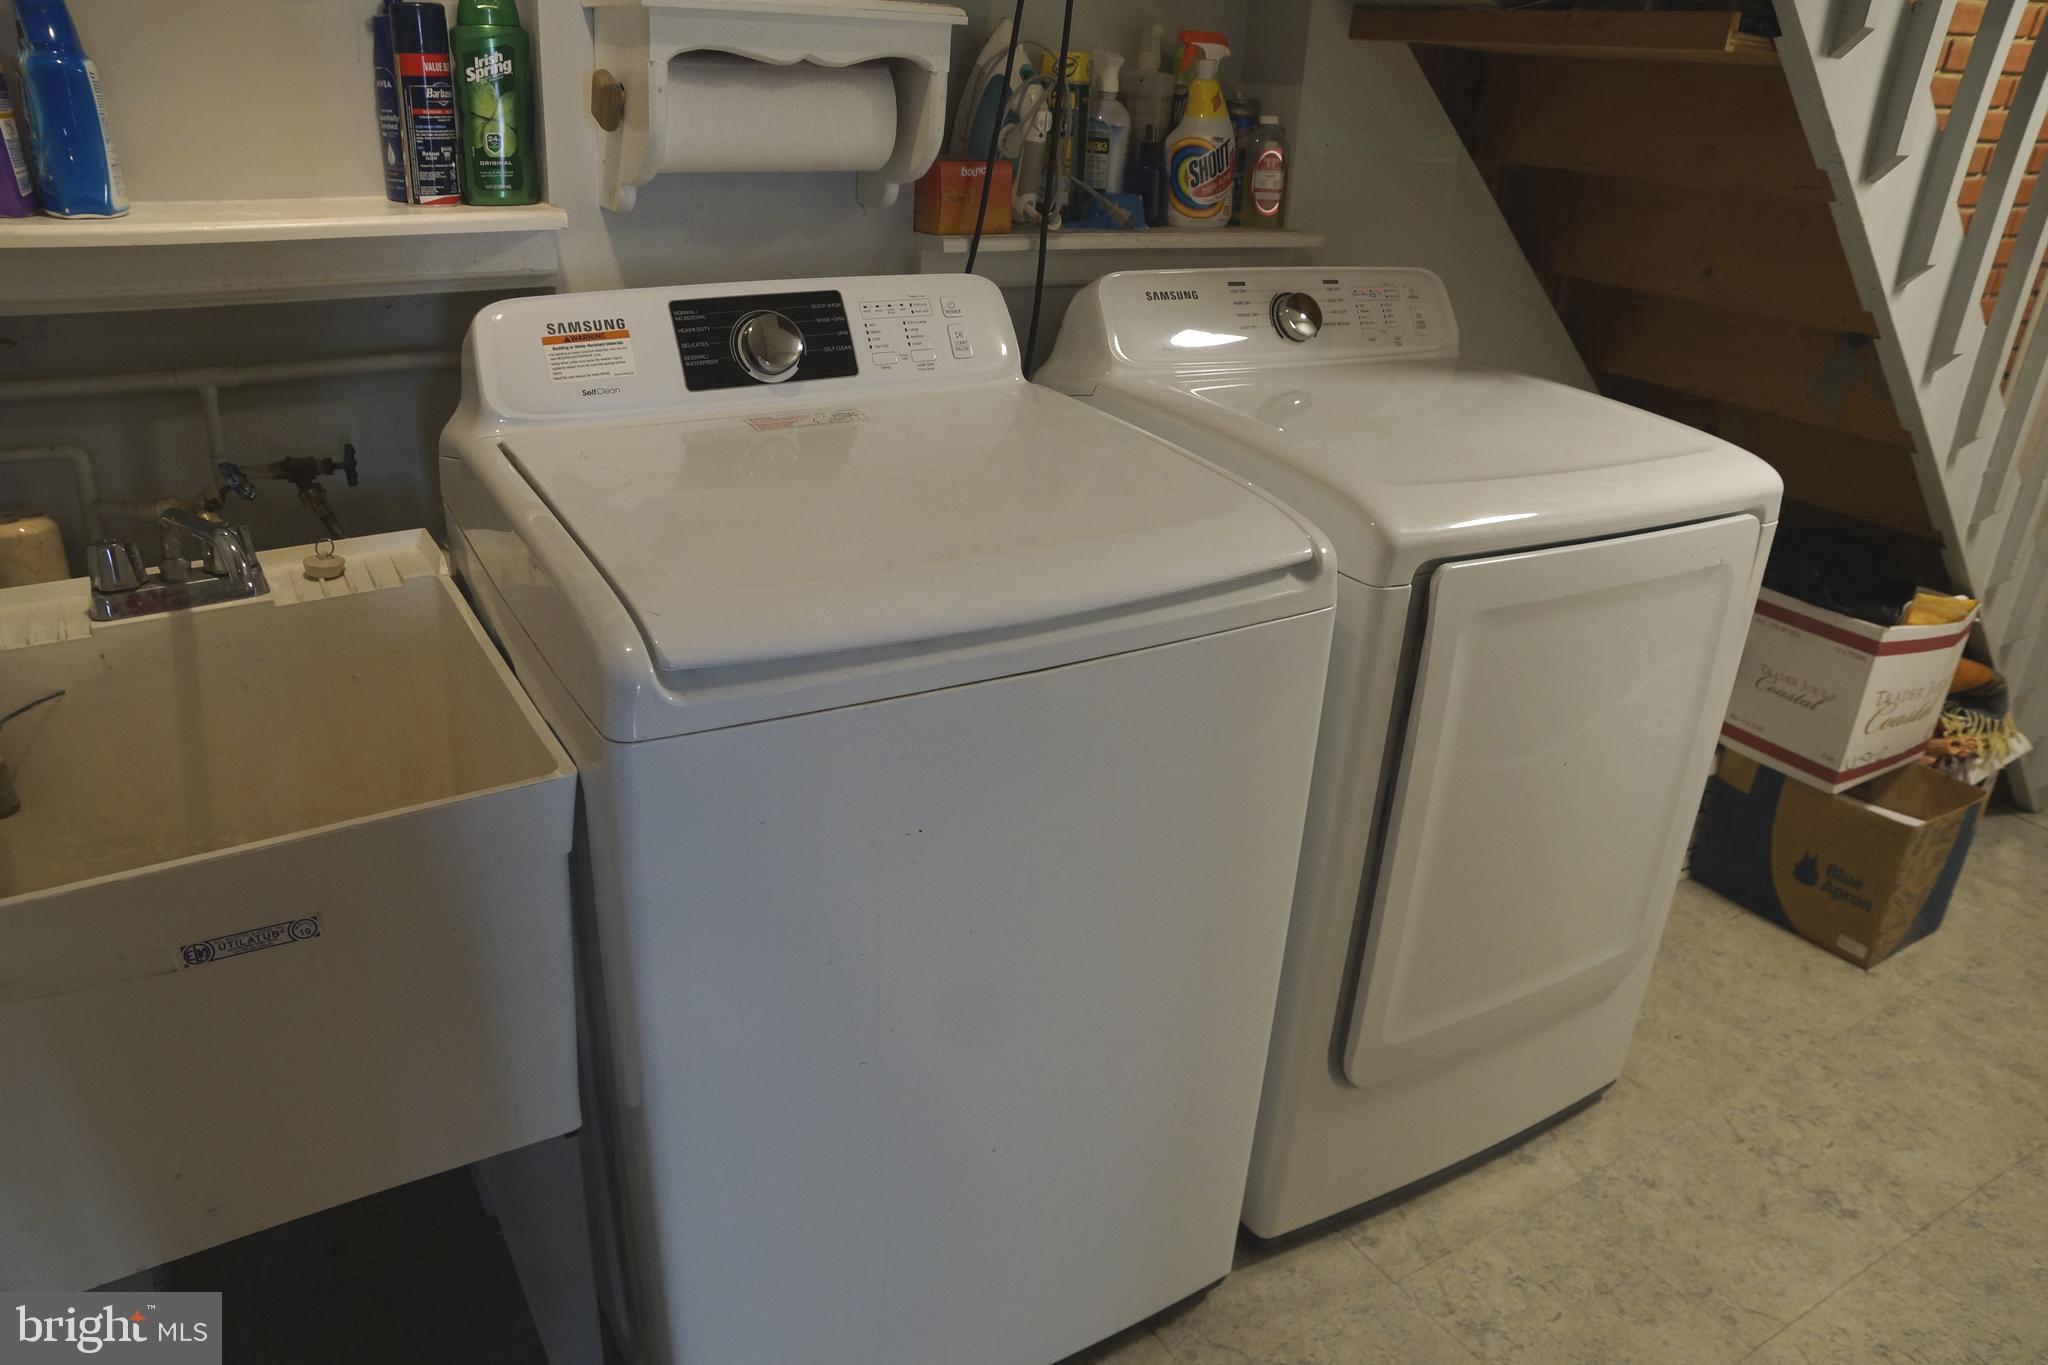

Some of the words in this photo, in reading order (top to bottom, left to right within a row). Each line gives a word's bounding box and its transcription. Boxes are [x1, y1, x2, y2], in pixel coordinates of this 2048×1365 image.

[424, 62, 443, 72] VALUE
[474, 51, 503, 68] Irish
[465, 59, 513, 83] Spring
[961, 166, 987, 177] bounc
[1188, 138, 1231, 188] SHOUT
[1145, 290, 1199, 301] SAMSUNG
[546, 318, 626, 335] SAMSUNG
[571, 332, 606, 342] WARNING
[582, 386, 621, 397] SelfClean
[1755, 675, 1838, 711] Coastal
[1876, 687, 1925, 706] TRADER
[1826, 863, 1864, 889] Blue
[1821, 879, 1873, 912] Apron
